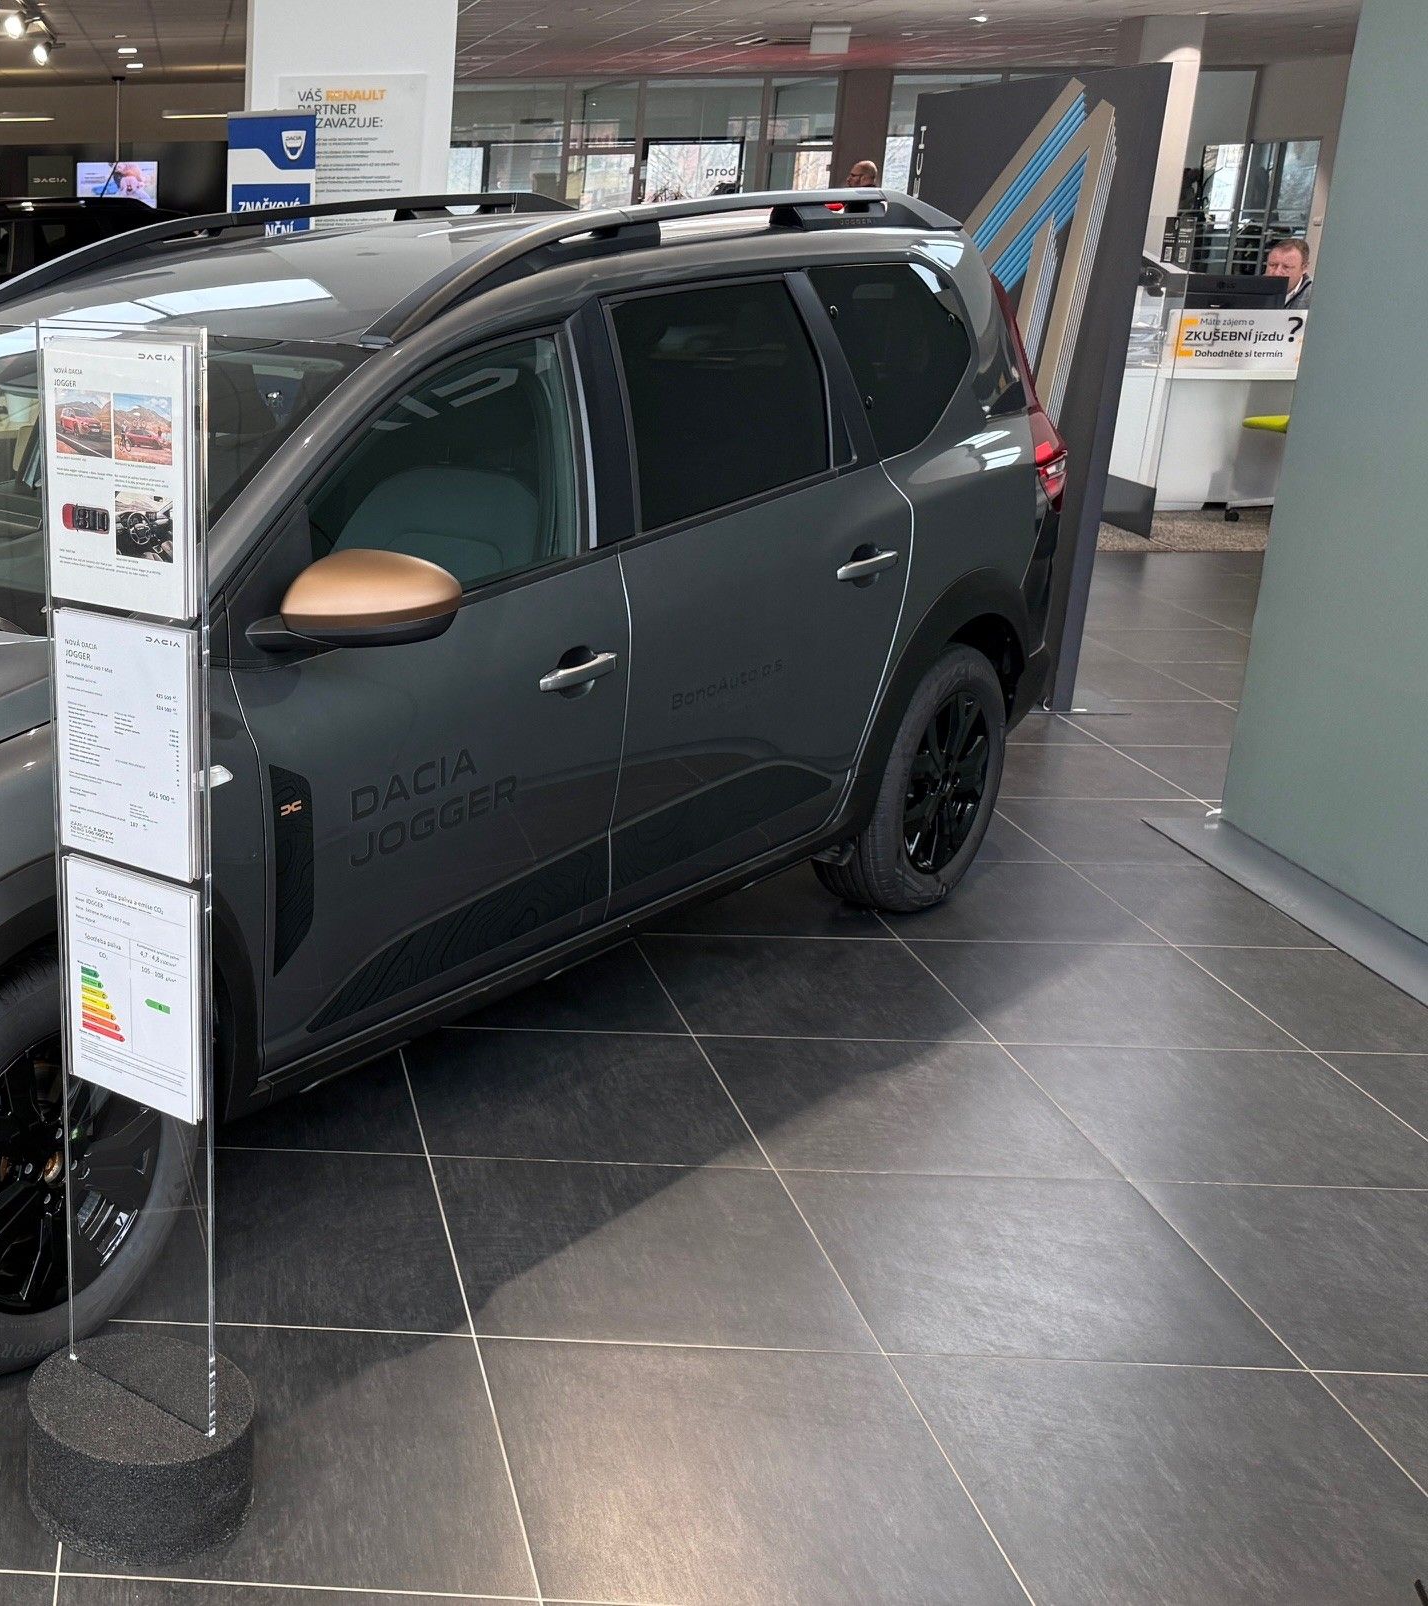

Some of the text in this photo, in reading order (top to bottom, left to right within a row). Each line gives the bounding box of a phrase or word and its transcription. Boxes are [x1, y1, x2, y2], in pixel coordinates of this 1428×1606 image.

[298, 88, 387, 101] VÁŠ RENAULT
[1200, 318, 1220, 326] Máte
[1223, 318, 1247, 327] zájem
[1288, 316, 1303, 343] ?
[1185, 329, 1284, 344] ZKUŠEBNÍ jízdu
[138, 353, 175, 361] DACIA
[1194, 350, 1243, 358] Dohodněte
[1254, 350, 1283, 358] termín
[54, 379, 77, 387] JOGGER
[65, 638, 98, 650] NOVÁ DACIA
[145, 636, 180, 648] DACIA
[65, 649, 91, 661] JOGGER
[350, 748, 478, 822] DACIA
[348, 774, 517, 868] JOGGER
[86, 898, 104, 909] JOGGER
